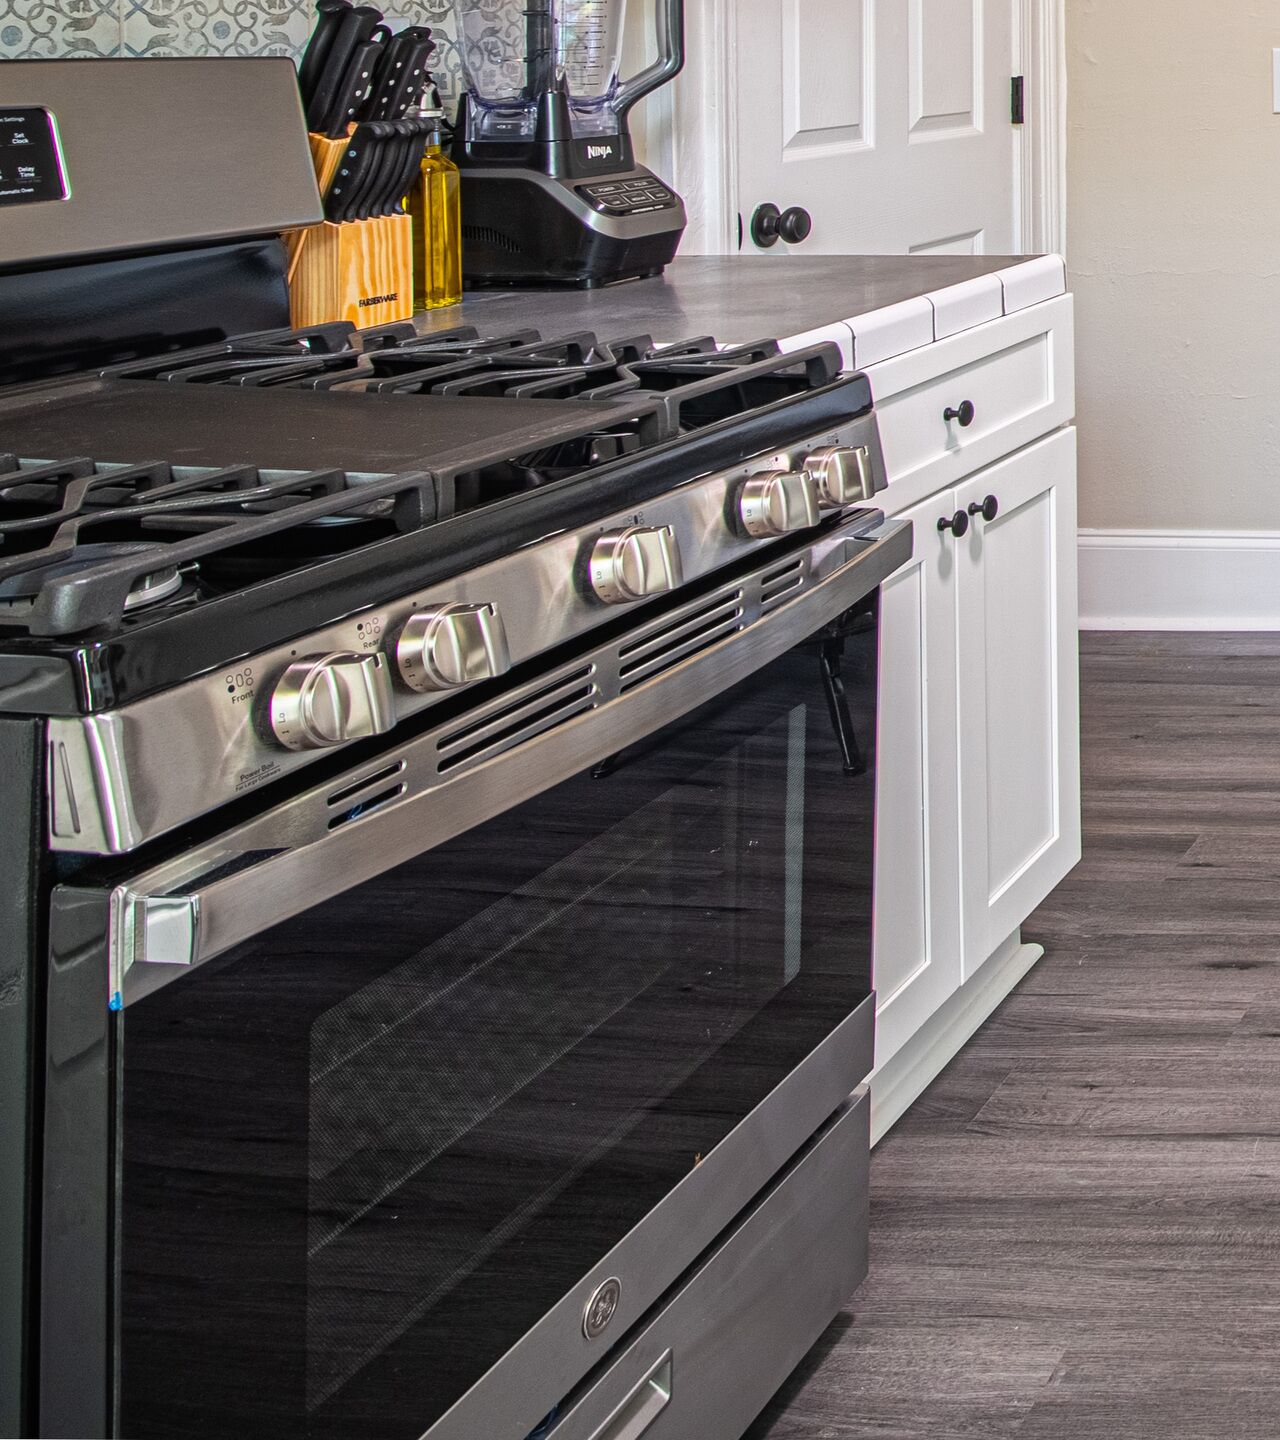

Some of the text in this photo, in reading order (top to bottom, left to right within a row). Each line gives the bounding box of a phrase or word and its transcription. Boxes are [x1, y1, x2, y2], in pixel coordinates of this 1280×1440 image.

[587, 145, 613, 159] NINJA
[363, 639, 379, 649] Rear
[231, 690, 254, 704] Front
[240, 769, 260, 781] Power
